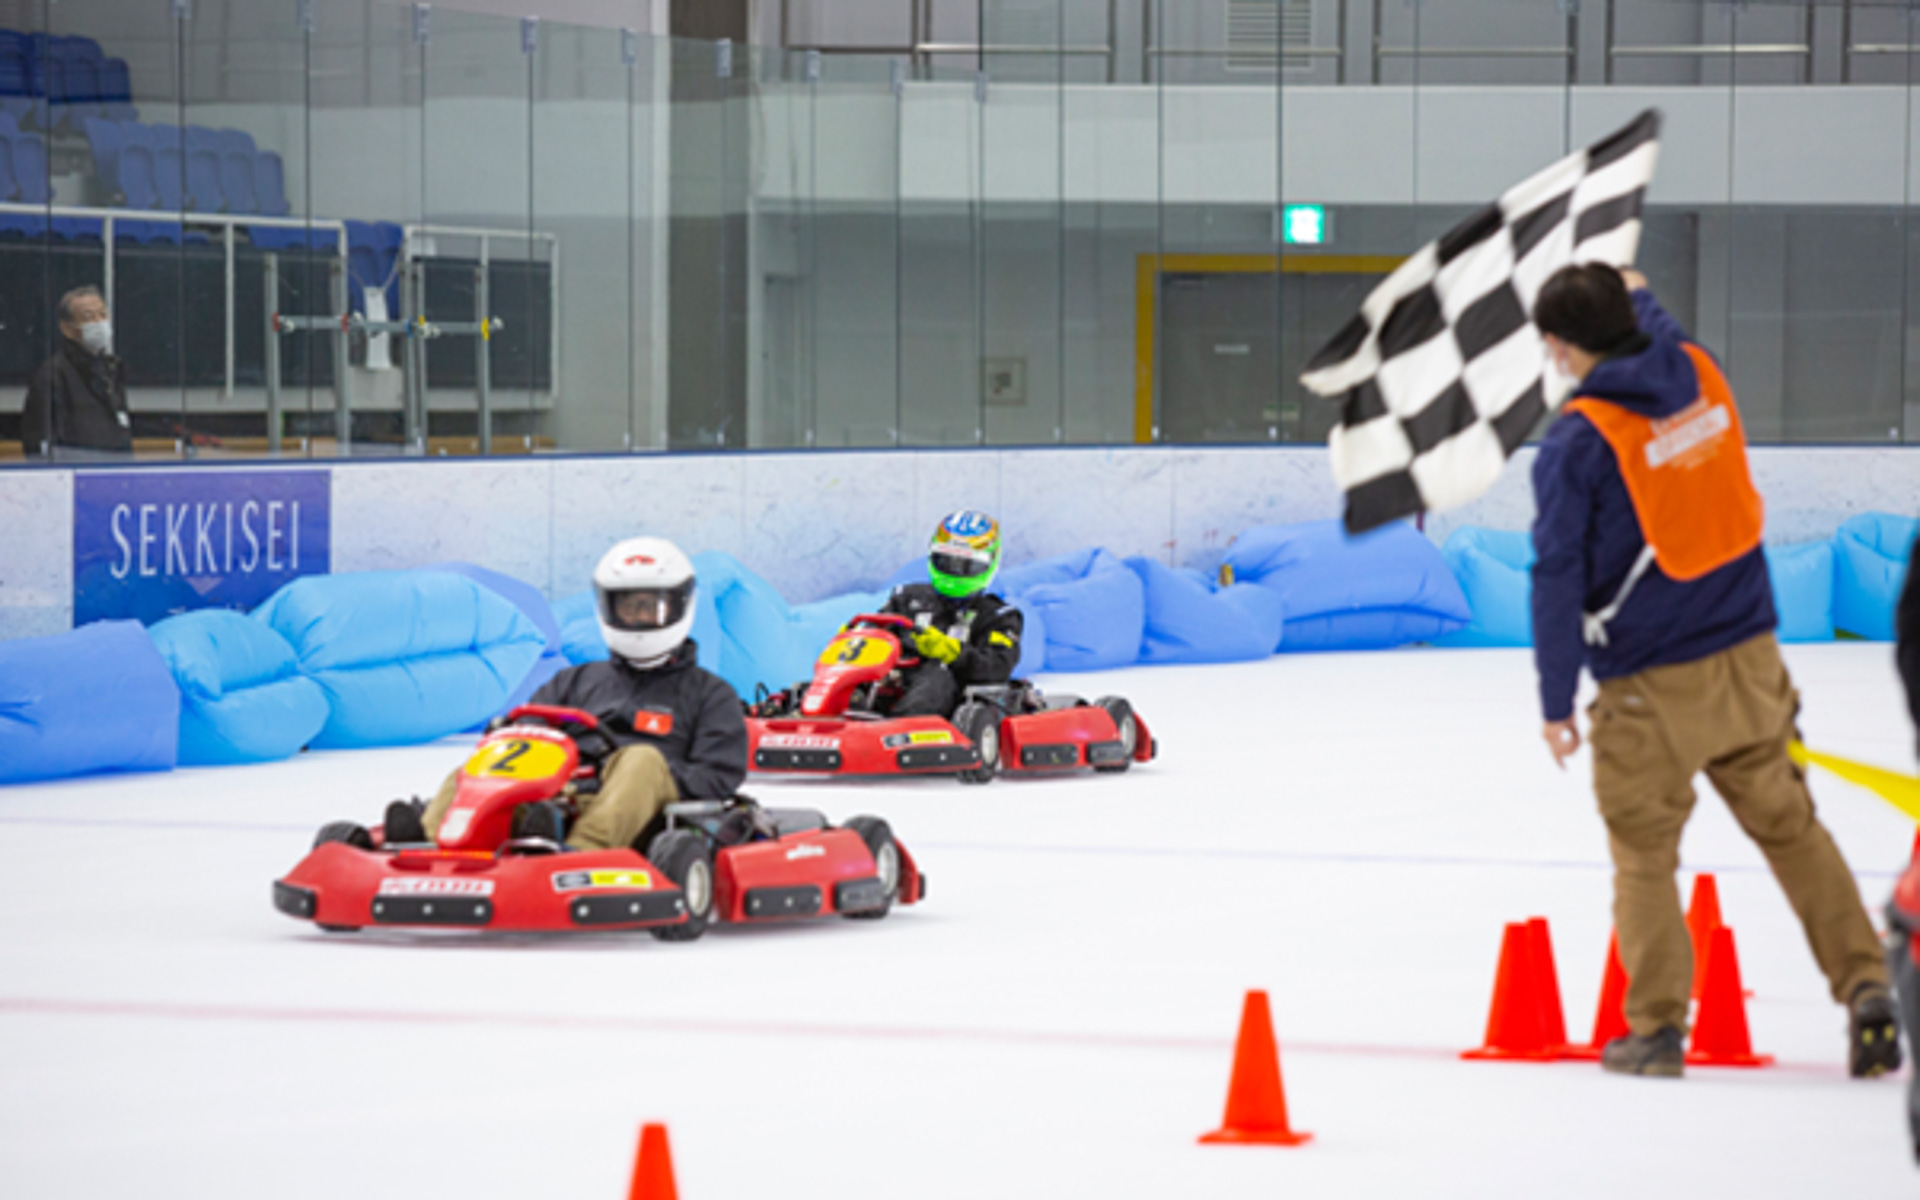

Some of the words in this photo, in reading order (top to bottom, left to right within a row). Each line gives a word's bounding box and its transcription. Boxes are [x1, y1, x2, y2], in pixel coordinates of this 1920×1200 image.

[110, 500, 299, 579] SEKKISEI
[838, 638, 868, 663] 3
[489, 740, 532, 773] 2
